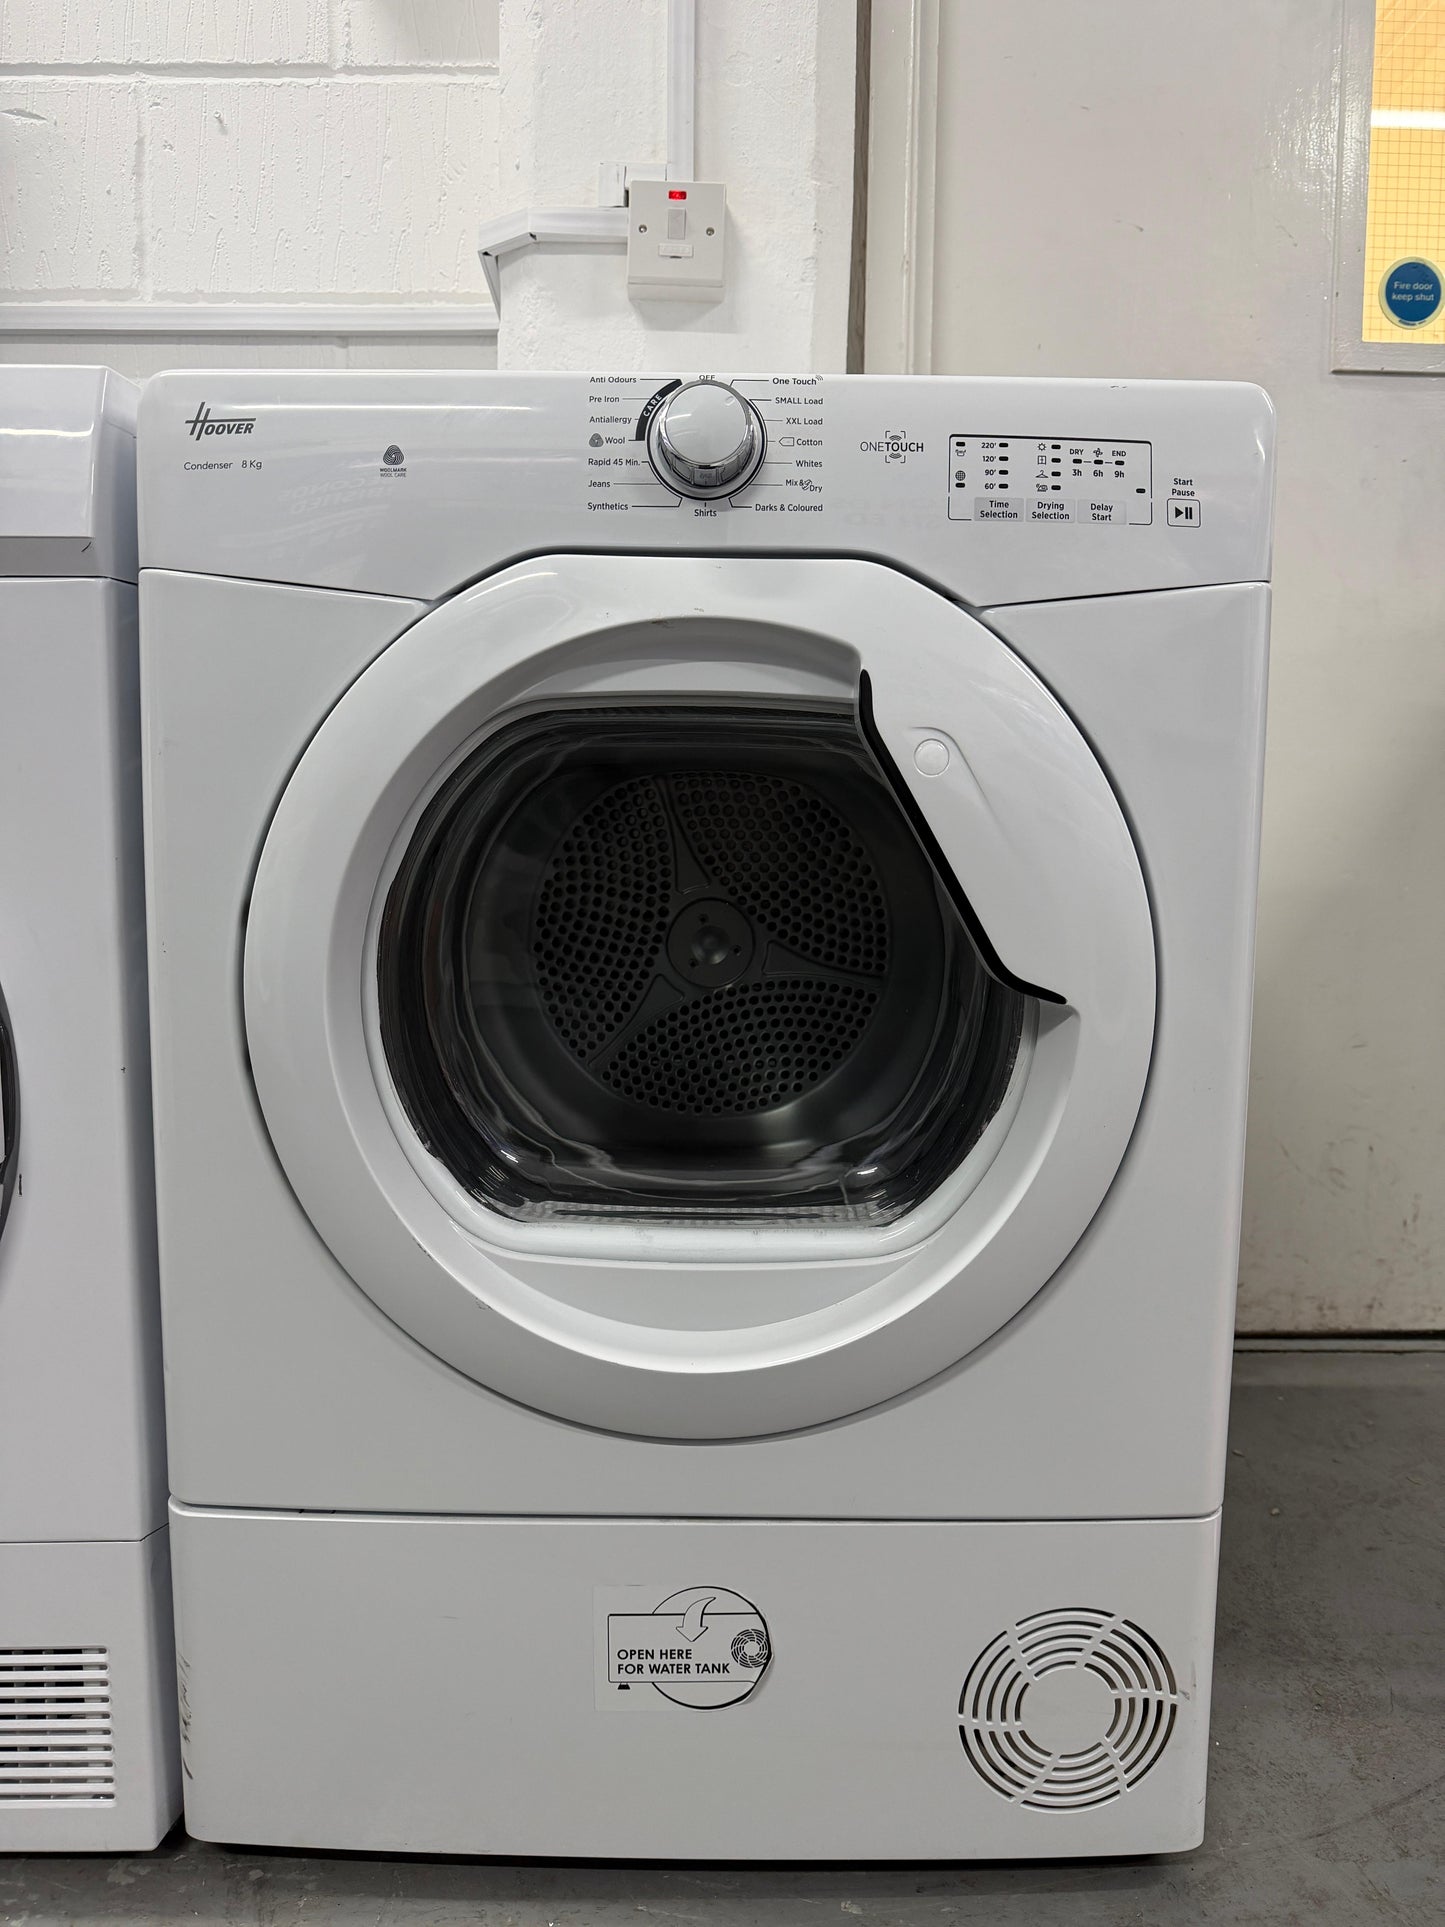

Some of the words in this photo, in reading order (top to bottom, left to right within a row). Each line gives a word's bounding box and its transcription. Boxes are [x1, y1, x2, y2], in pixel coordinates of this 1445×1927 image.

[1394, 281, 1411, 289] Fire
[1412, 282, 1433, 290] door
[1392, 293, 1413, 302] keep
[643, 394, 662, 416] CARE
[590, 416, 632, 424] Antiallergy
[184, 461, 233, 471] Condenser
[241, 460, 248, 469] 8
[249, 460, 263, 470] Kg
[1072, 469, 1082, 477] 3h
[1173, 478, 1193, 486] Start
[1171, 488, 1195, 497] Pause
[587, 502, 628, 510] Synthetics
[989, 500, 1009, 508] Time
[1037, 501, 1065, 511] Drying
[1090, 503, 1113, 512] Delay
[694, 509, 717, 517] Shirts
[980, 510, 1018, 519] Selection
[1031, 511, 1070, 520] Selection
[1091, 512, 1112, 521] Start
[617, 1649, 655, 1660] OPEN
[659, 1649, 693, 1660] HERE
[617, 1663, 644, 1674] FOR
[649, 1663, 691, 1674] WATER
[695, 1663, 730, 1674] TANK
